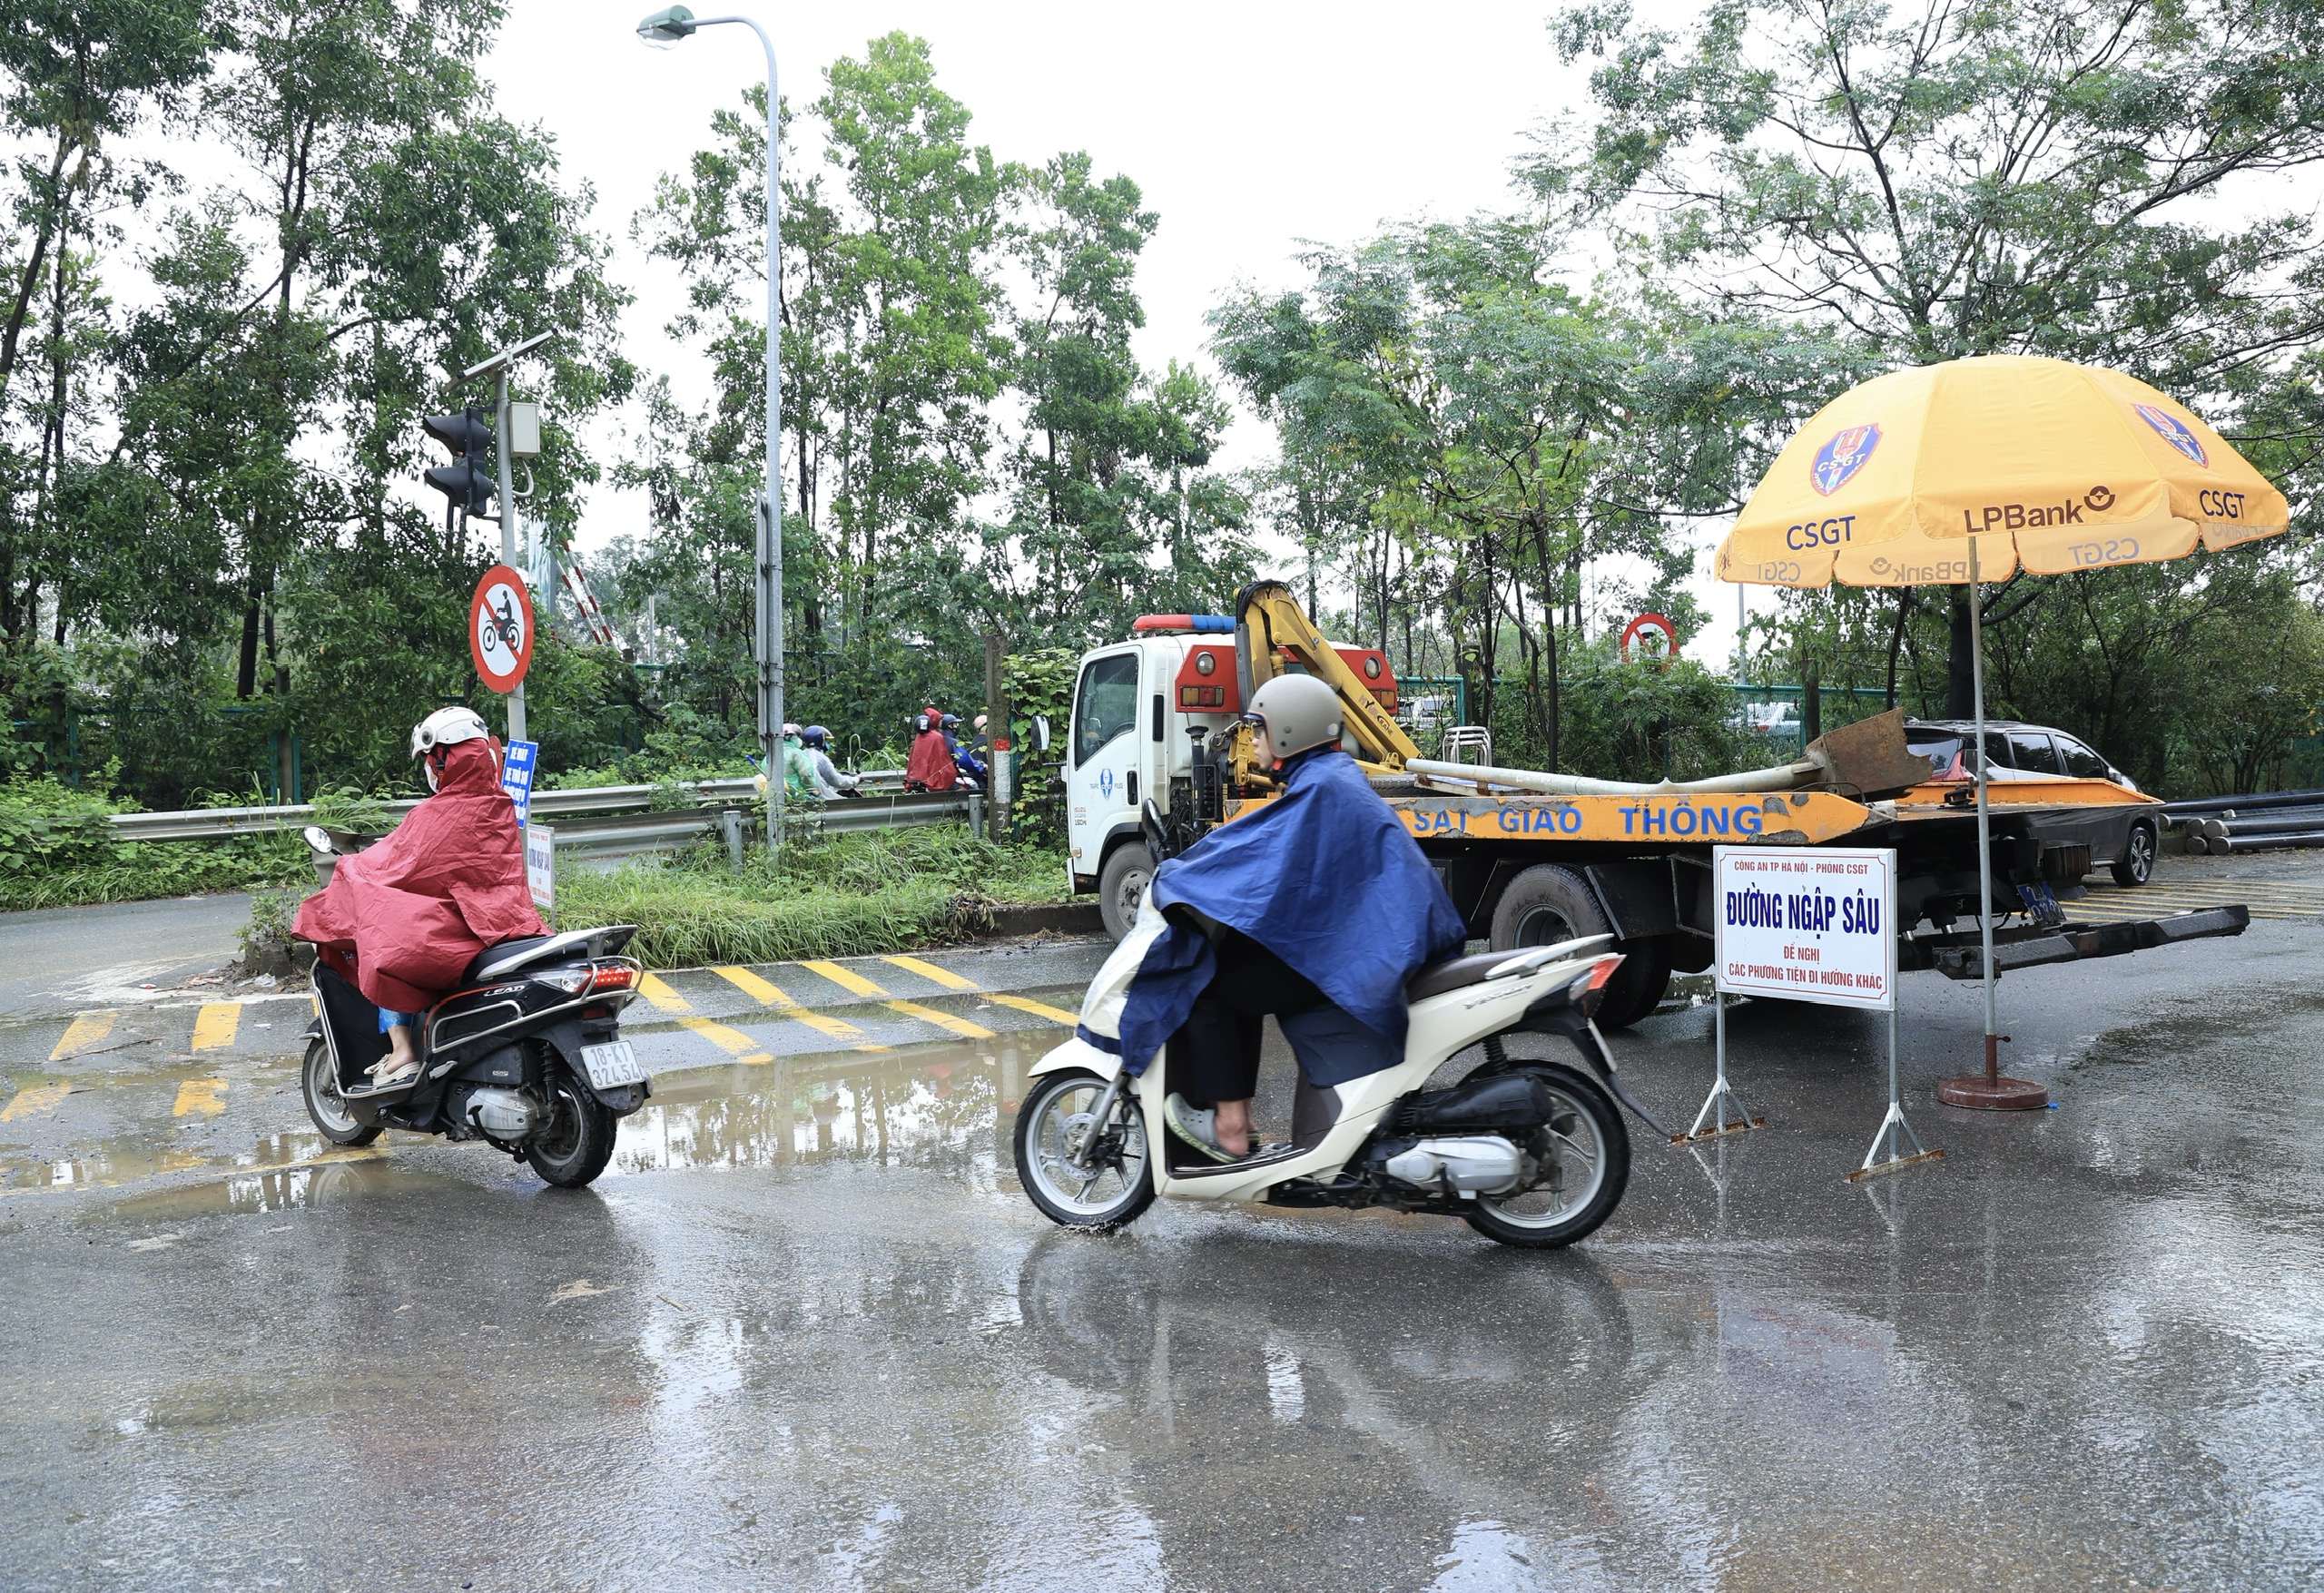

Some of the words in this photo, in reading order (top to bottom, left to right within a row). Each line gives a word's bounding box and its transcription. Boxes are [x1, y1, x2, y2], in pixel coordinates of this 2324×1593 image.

[1817, 453, 1866, 472] CSGT
[1964, 498, 2084, 533] LPBank
[2200, 489, 2245, 519] CSGT
[1787, 516, 1856, 550] CSGT
[1498, 806, 1583, 833] GIAO
[1618, 801, 1762, 835] THÔNG
[1735, 860, 1755, 871] CÔNG
[1758, 861, 1768, 871] AN
[1770, 862, 1779, 872] TP
[1781, 860, 1792, 872] HÀ
[1795, 860, 1807, 875] NỘI
[1817, 861, 1844, 874] PHÒNG
[1846, 863, 1868, 874] CSGT
[1727, 882, 1782, 929] ĐƯỜNG
[1788, 886, 1836, 939] NGẬP
[1843, 888, 1879, 935] SÂU
[1784, 941, 1795, 959] ĐỀ
[1797, 947, 1820, 965] NGHỊ
[1728, 961, 1746, 977] CÁC
[1748, 965, 1784, 980] PHƯƠNG
[1786, 966, 1806, 985] TIỆN
[1808, 969, 1818, 983] ĐI
[1821, 969, 1853, 987] HƯỚNG
[1856, 972, 1883, 989] KHÁC
[483, 985, 526, 997] LEAD
[590, 1044, 628, 1067] 18-K1
[593, 1063, 640, 1086] 324.54
